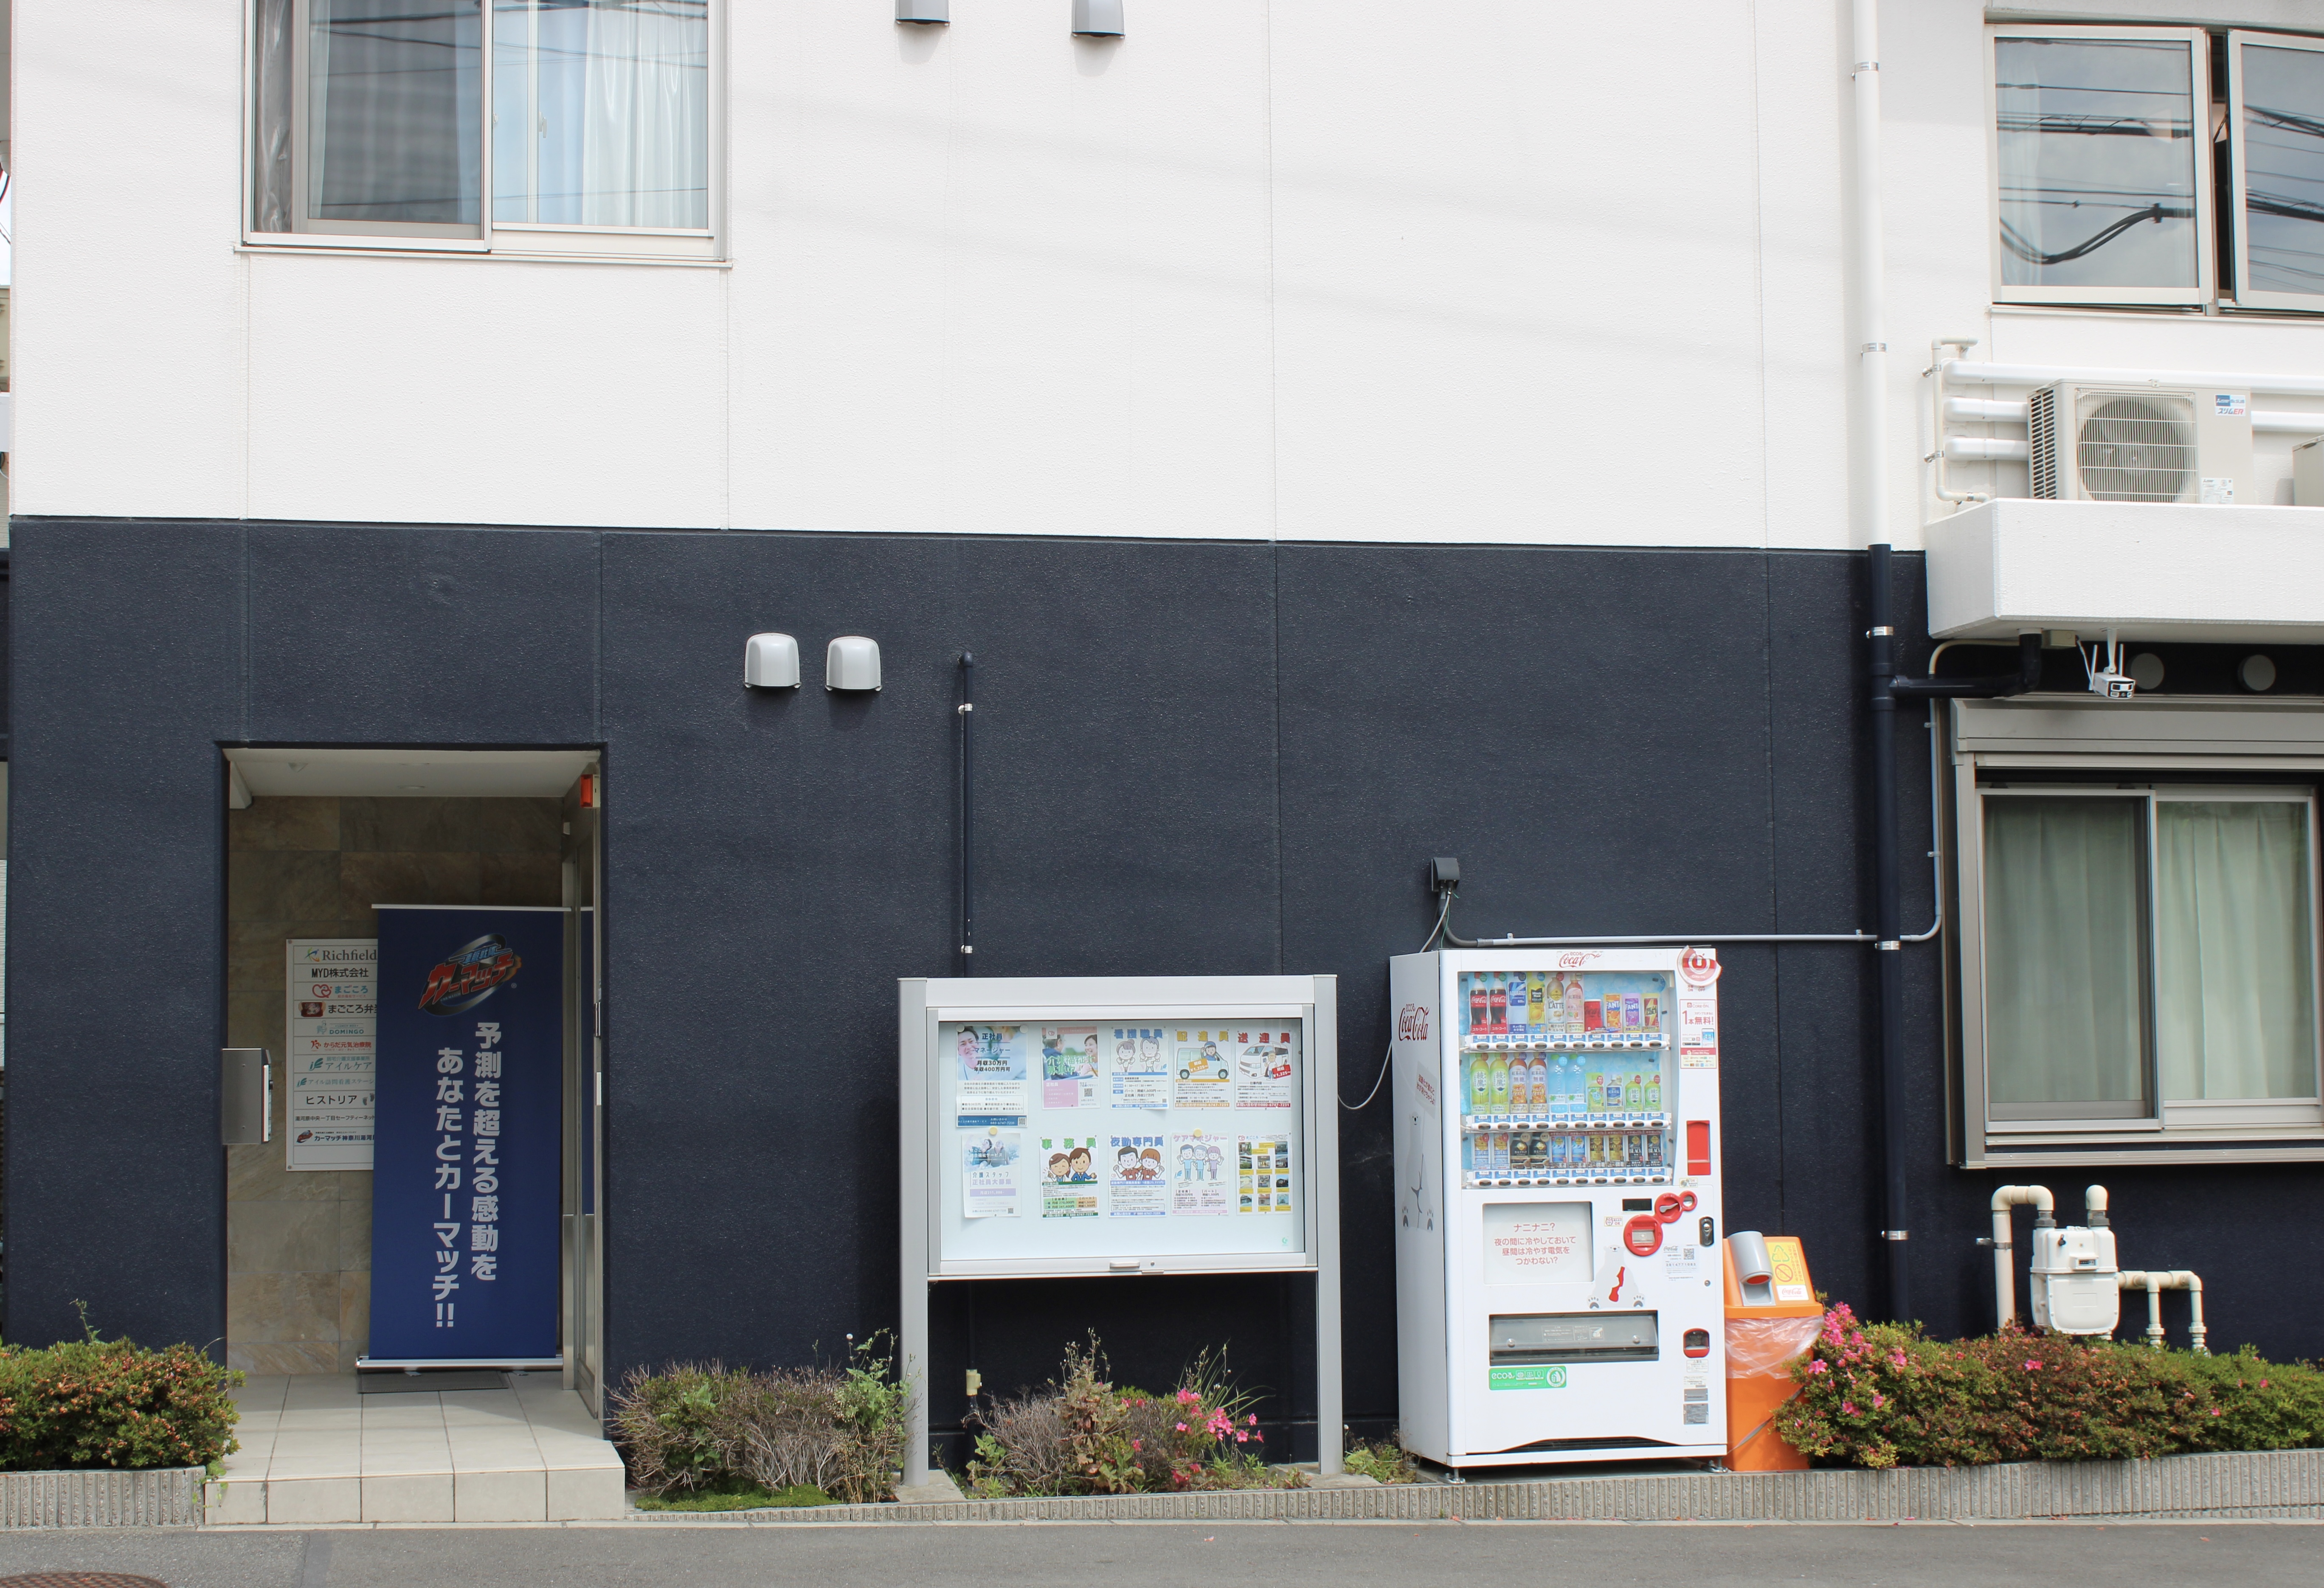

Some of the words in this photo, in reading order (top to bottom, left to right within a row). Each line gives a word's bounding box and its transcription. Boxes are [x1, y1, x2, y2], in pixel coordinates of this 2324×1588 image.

[322, 949, 377, 961] Richfield
[312, 968, 369, 978] MYD株式会社
[418, 952, 514, 1009] カーマッチ
[335, 985, 368, 994] まごころ
[1607, 1001, 1621, 1009] FANT
[1176, 1031, 1229, 1042] 配達員
[1238, 1032, 1291, 1043] 送迎員
[326, 1062, 372, 1071] アイルケア
[1477, 1071, 1485, 1087] 綾鷹
[1496, 1071, 1504, 1087] 綾鷹
[307, 1095, 357, 1105] ヒストリア
[1041, 1137, 1097, 1150] 事務員
[1110, 1136, 1164, 1147] 夜勤専門員
[471, 1022, 502, 1281] 予測を超える感動を
[1514, 1223, 1556, 1232] ナニナニ?
[1494, 1236, 1576, 1246] 夜の間に冷やしておいて
[1502, 1246, 1570, 1256] 昼間は冷やす電気を
[1516, 1256, 1558, 1265] つかわない?
